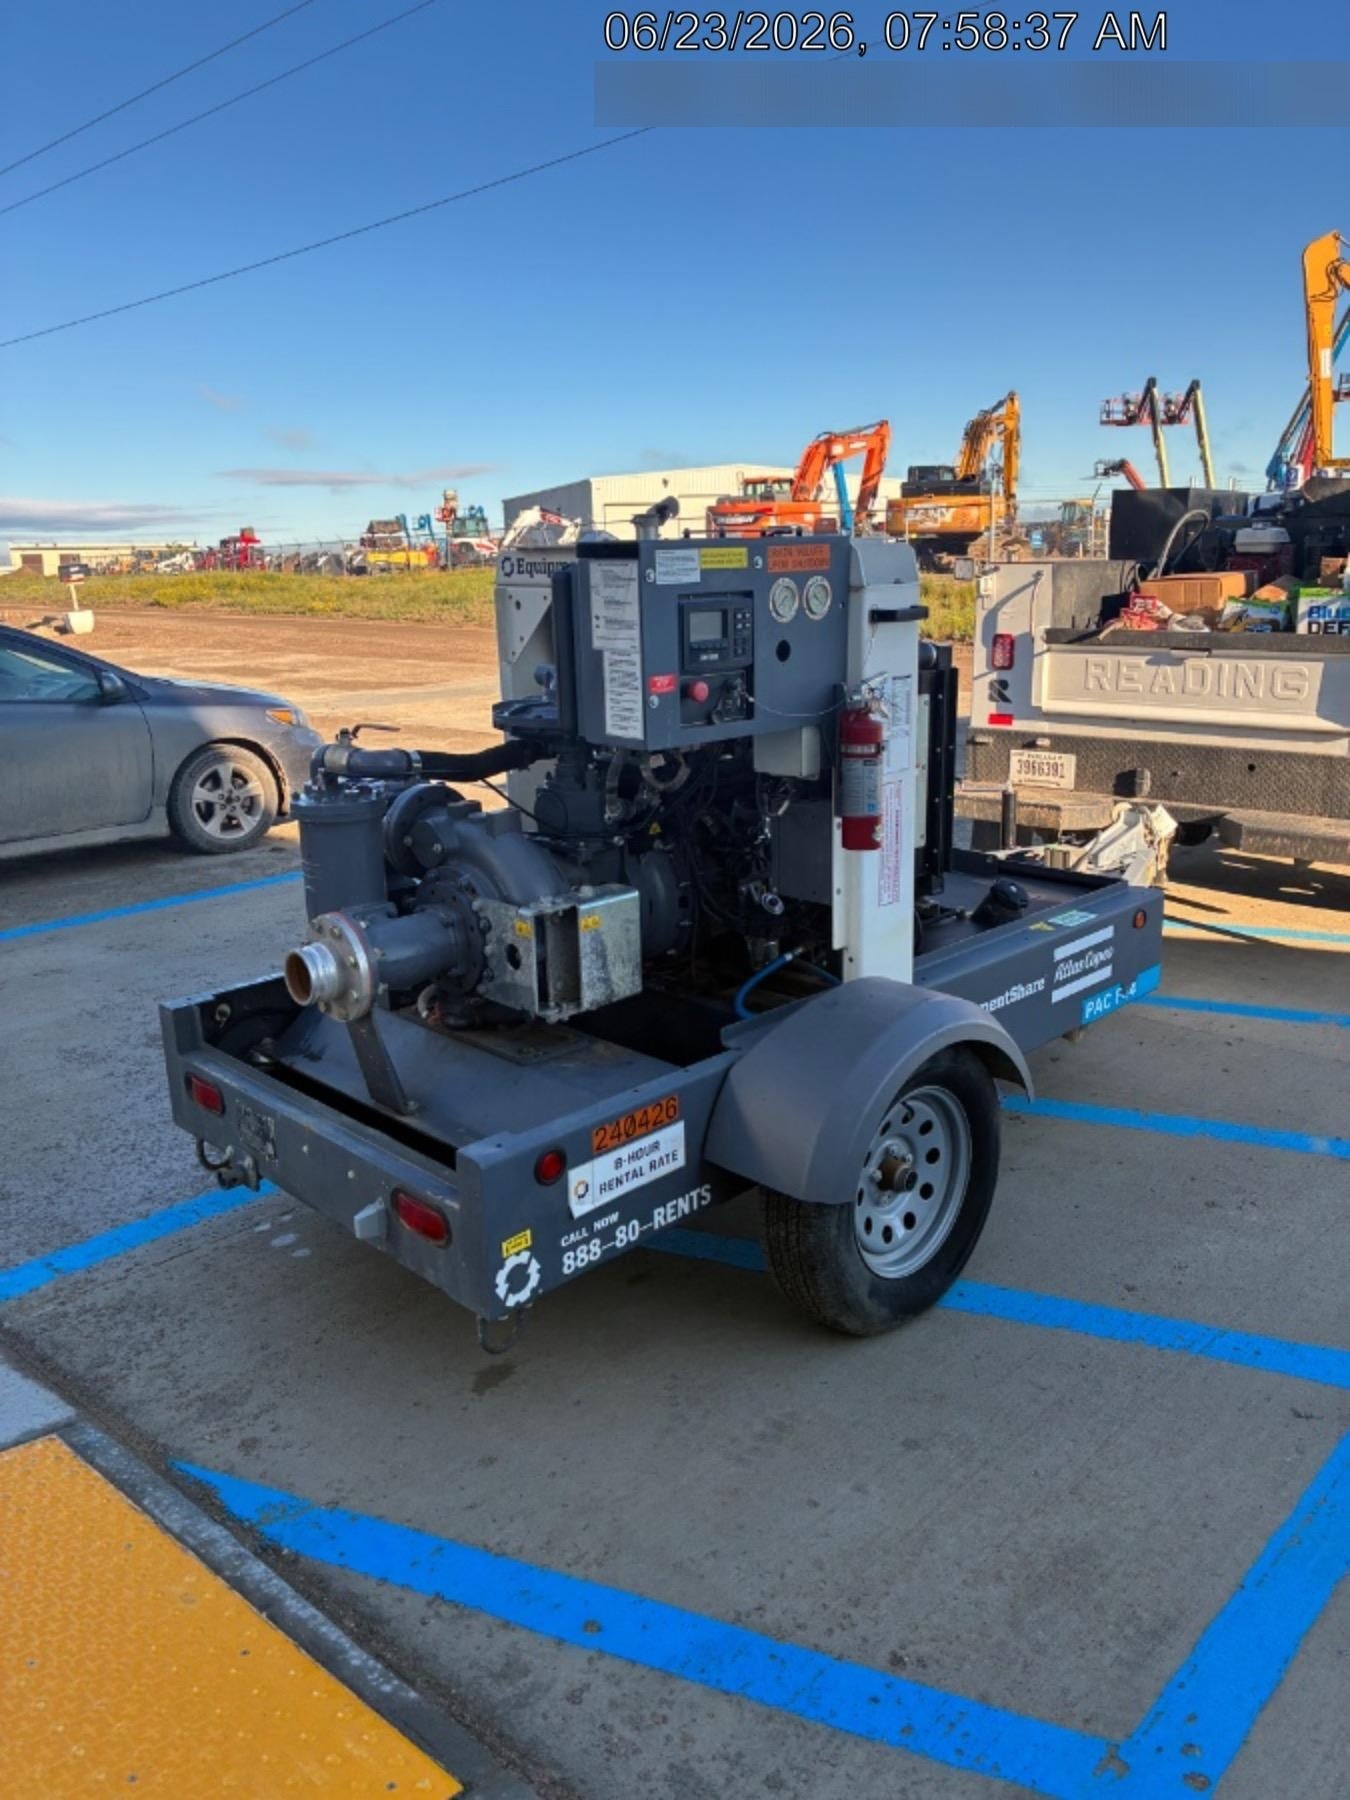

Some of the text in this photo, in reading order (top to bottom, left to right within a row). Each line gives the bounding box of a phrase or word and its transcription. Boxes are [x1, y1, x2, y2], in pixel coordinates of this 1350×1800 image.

[1084, 656, 1309, 700] READING
[1085, 993, 1112, 1019] PAC
[594, 1095, 679, 1151] 240426
[599, 1149, 679, 1195] RENTAL RATE
[561, 1211, 619, 1247] CALL NOW
